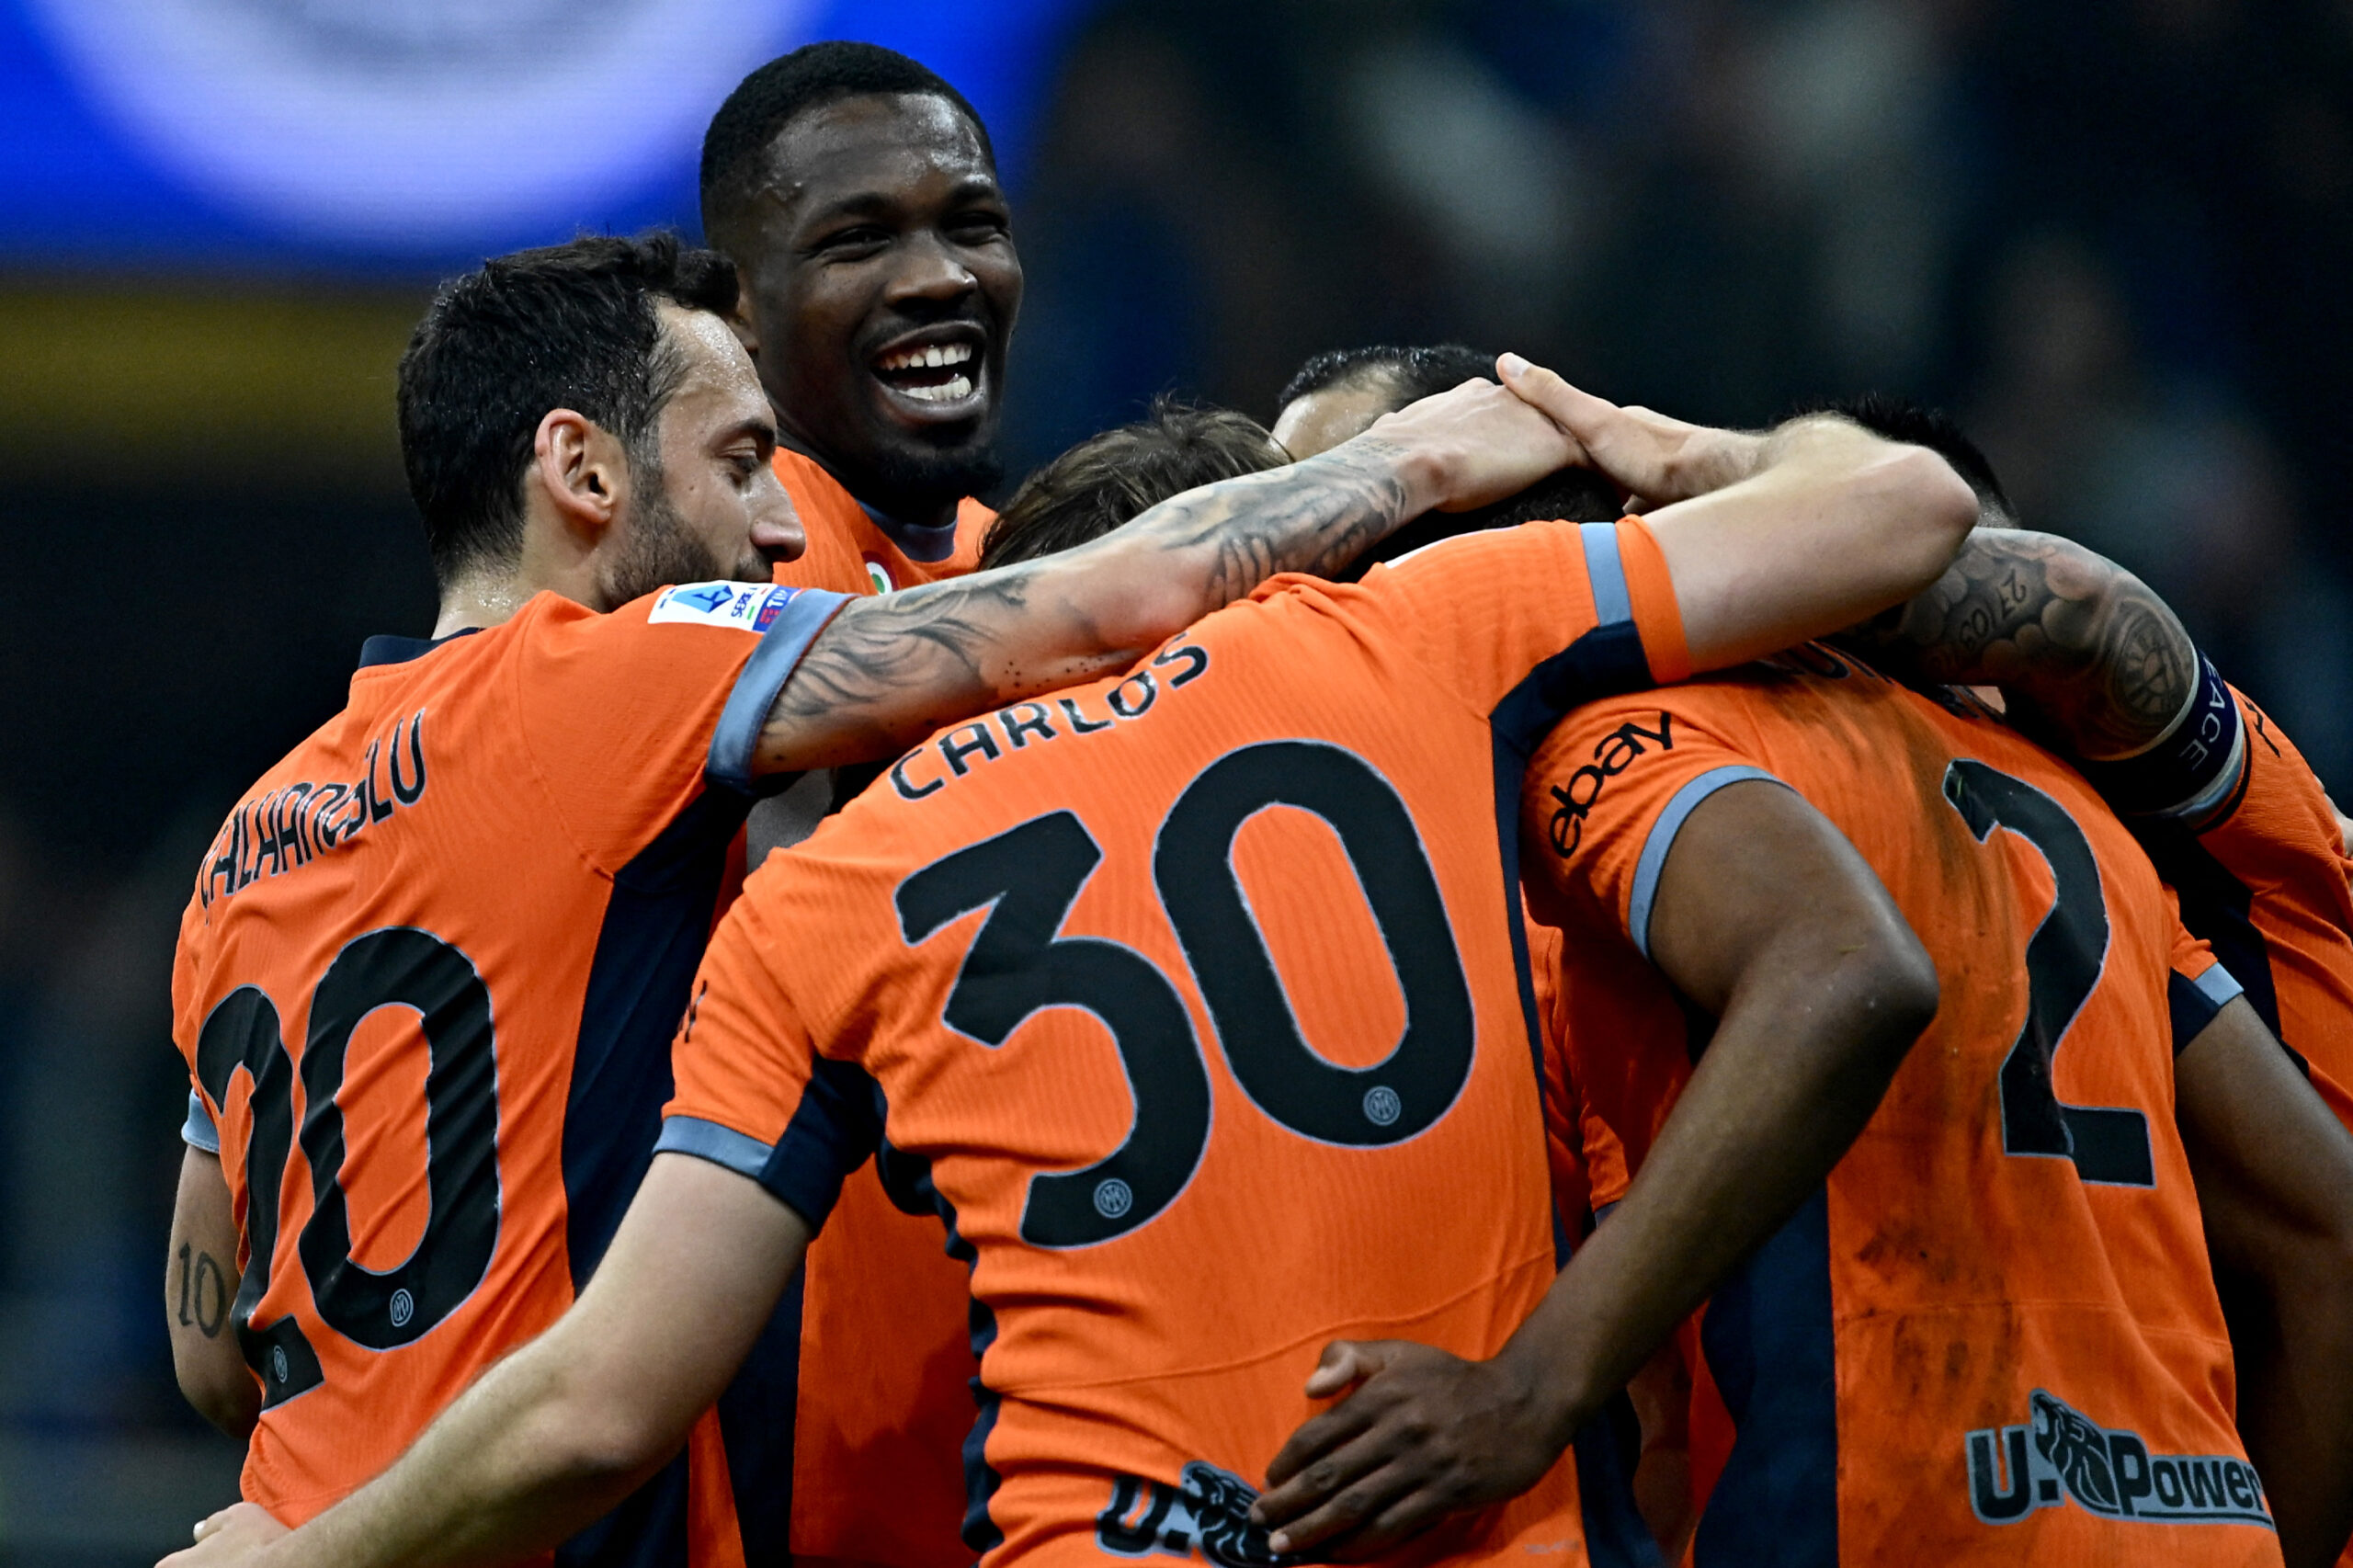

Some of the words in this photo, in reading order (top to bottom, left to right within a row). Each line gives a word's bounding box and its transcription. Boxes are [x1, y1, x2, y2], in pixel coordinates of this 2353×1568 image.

[890, 632, 1209, 801] CARLOS
[1550, 711, 1673, 858] ebay
[2179, 649, 2225, 770] EACE
[894, 738, 1476, 1248] 30
[1942, 757, 2157, 1188] 2
[196, 926, 502, 1414] 20
[179, 1242, 226, 1339] 10
